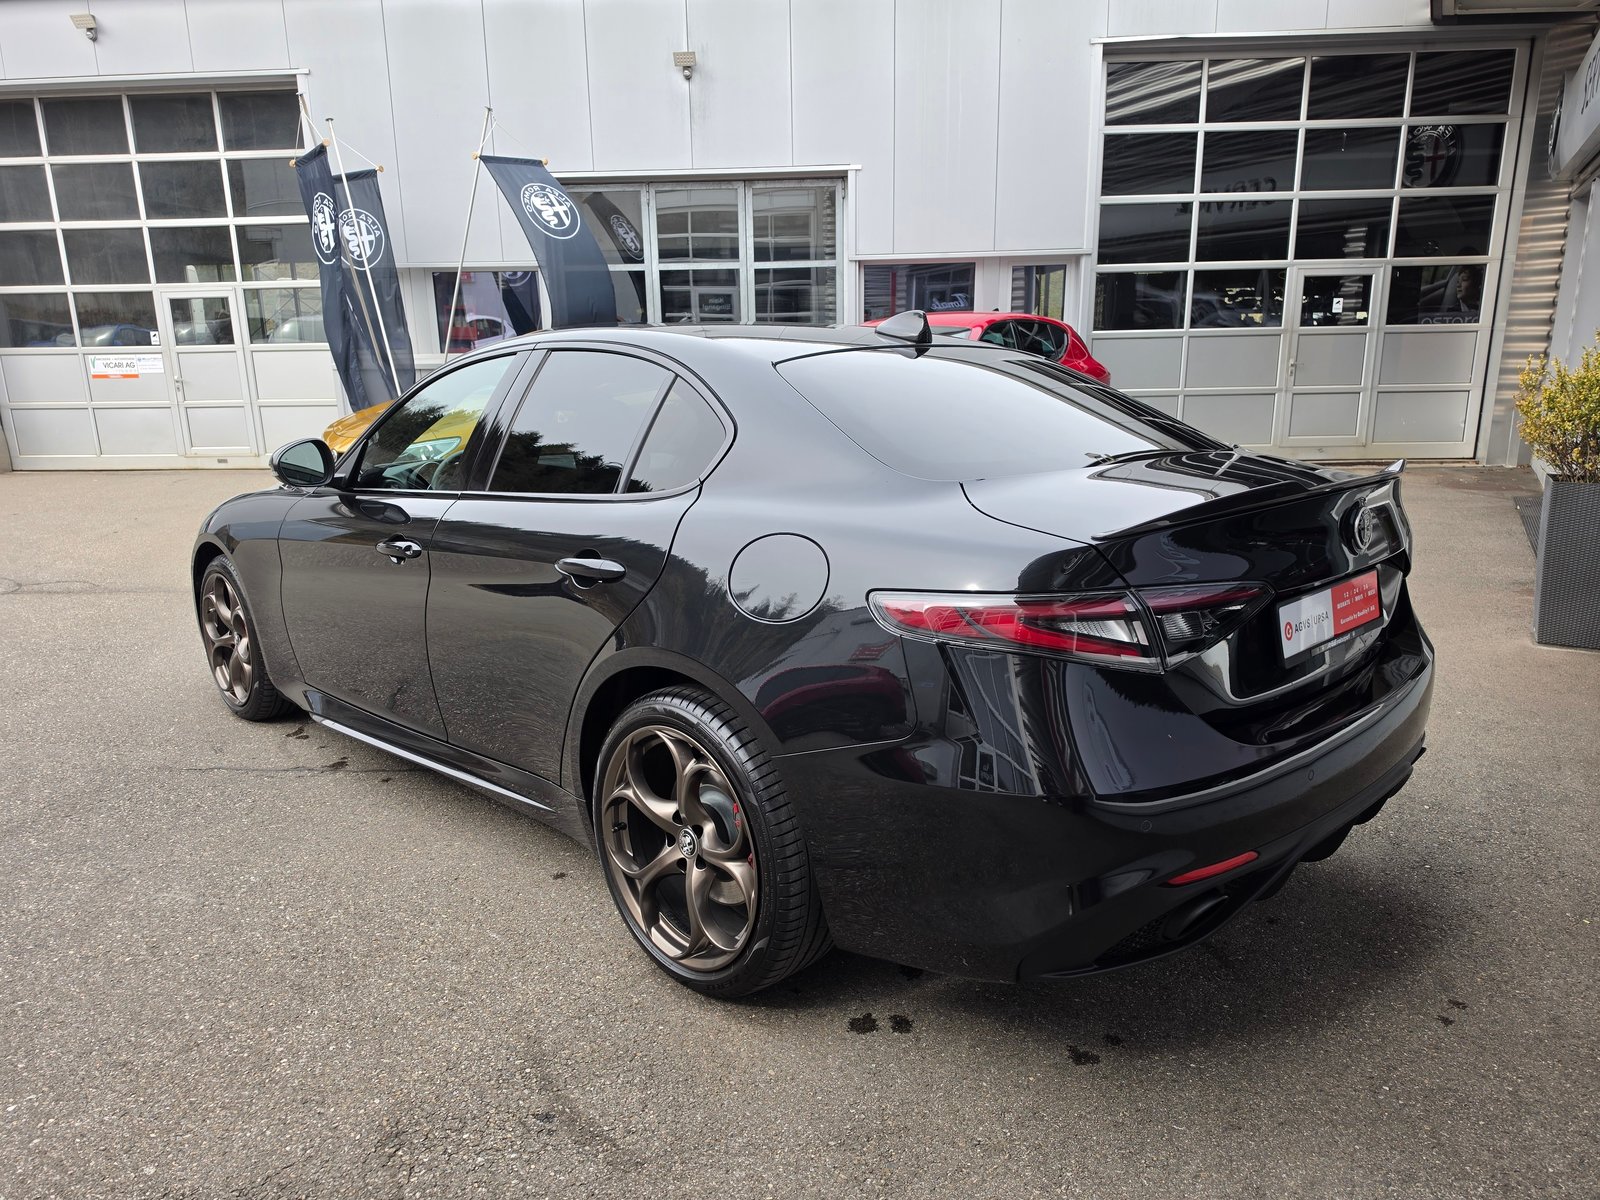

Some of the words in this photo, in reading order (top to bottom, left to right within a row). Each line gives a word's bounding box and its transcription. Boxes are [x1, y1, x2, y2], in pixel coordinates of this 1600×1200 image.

[102, 361, 124, 369] VICARI
[125, 361, 136, 369] AG
[1294, 618, 1311, 634] AGVS
[1313, 610, 1329, 625] UPSA
